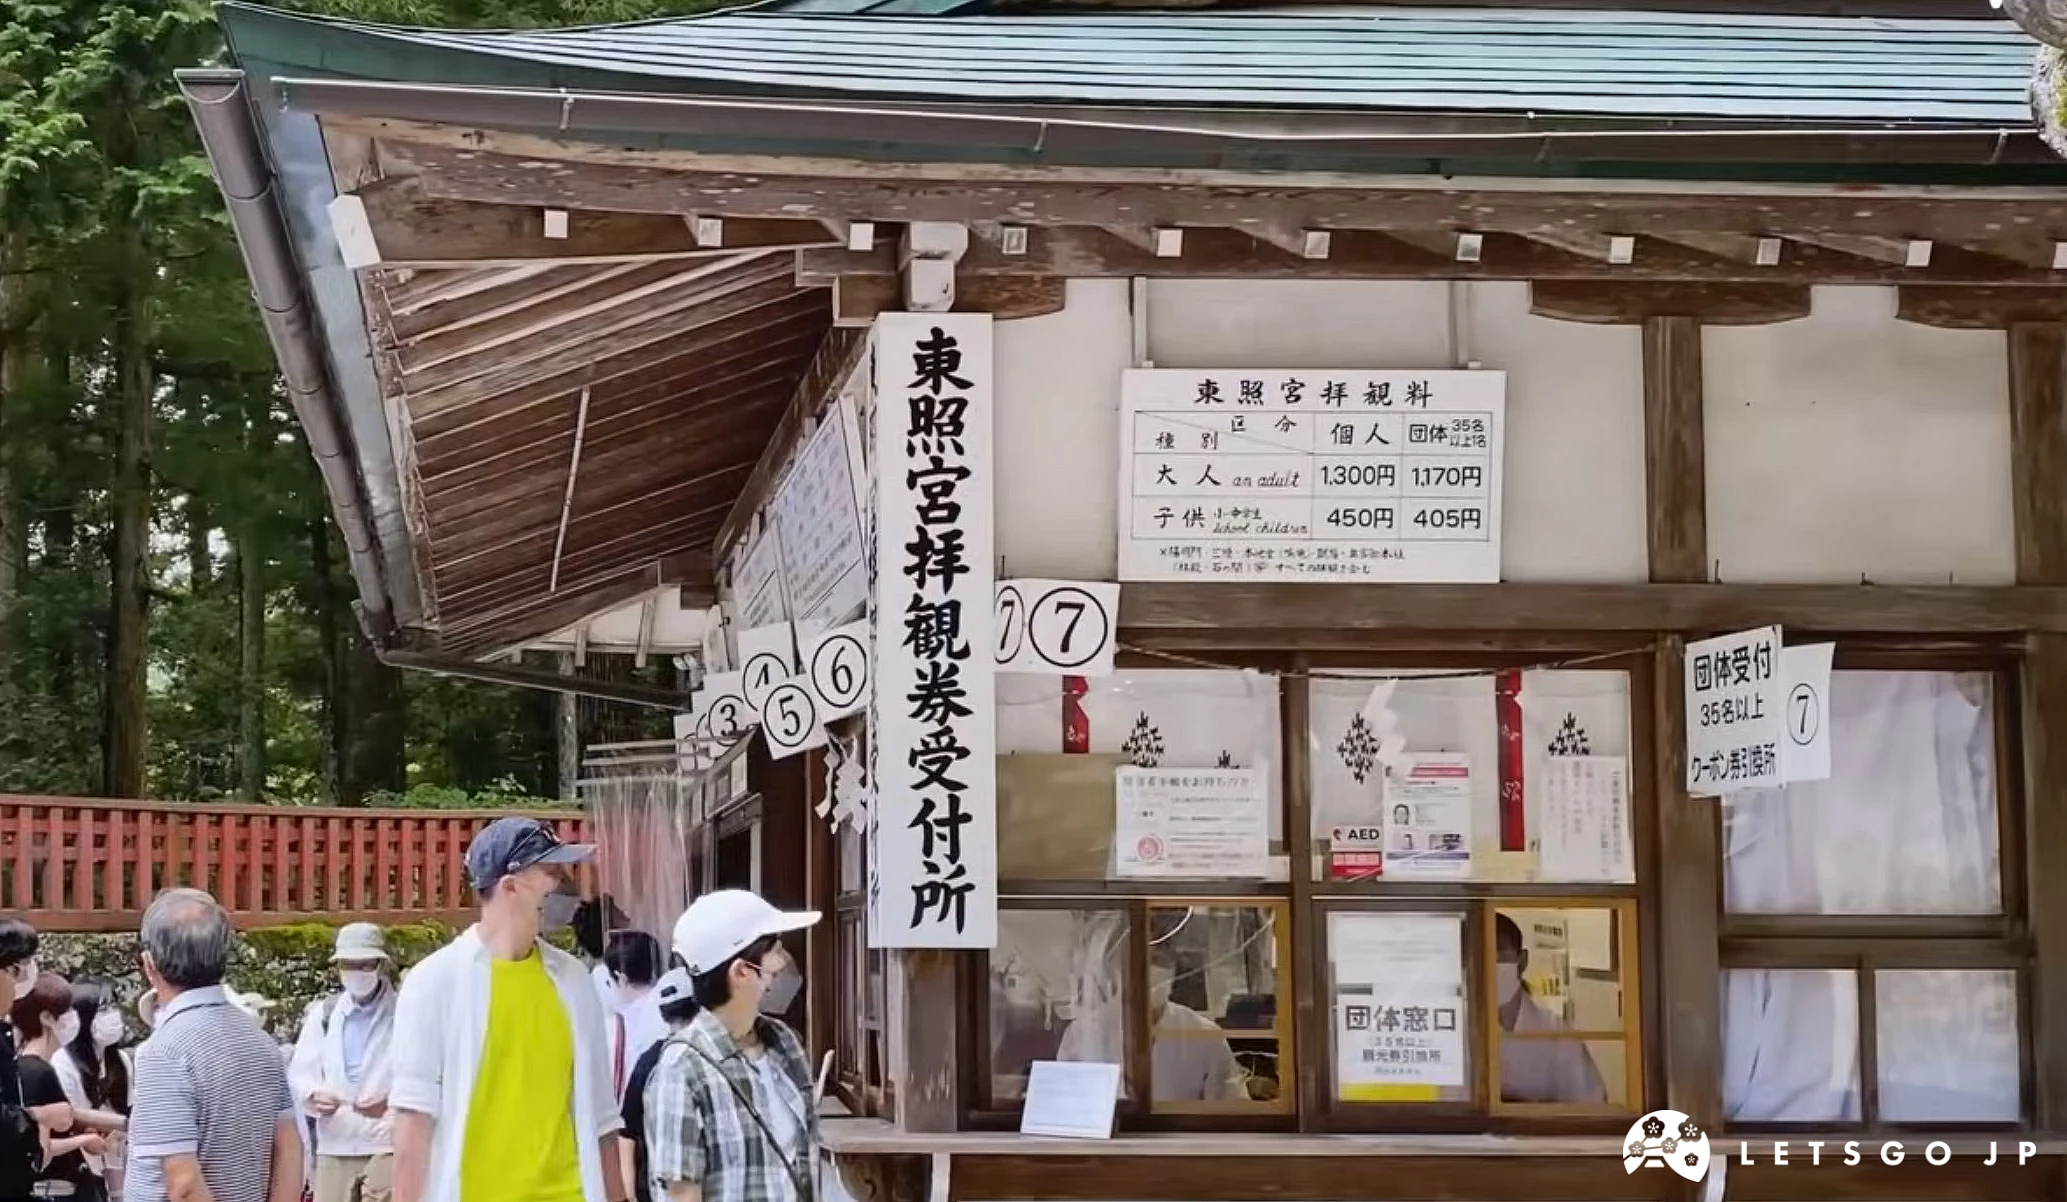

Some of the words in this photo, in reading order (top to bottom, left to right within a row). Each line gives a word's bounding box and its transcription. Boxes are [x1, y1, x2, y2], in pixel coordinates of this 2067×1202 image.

[1194, 378, 1433, 407] 東照宮拝観料
[1330, 422, 1390, 445] 個人
[1409, 424, 1448, 443] 団体
[1156, 463, 1221, 486] 大人
[1232, 474, 1252, 487] an
[1257, 471, 1300, 488] adult
[1153, 506, 1206, 529] 子供
[1327, 508, 1394, 529] 450円
[1413, 508, 1482, 530] 405円
[902, 326, 976, 936] 東照宮拝観券受付所
[1694, 641, 1771, 692] 団体受付
[1700, 692, 1765, 727] 35名以上
[1348, 828, 1380, 840] AED
[1345, 1005, 1457, 1032] 団体窓口
